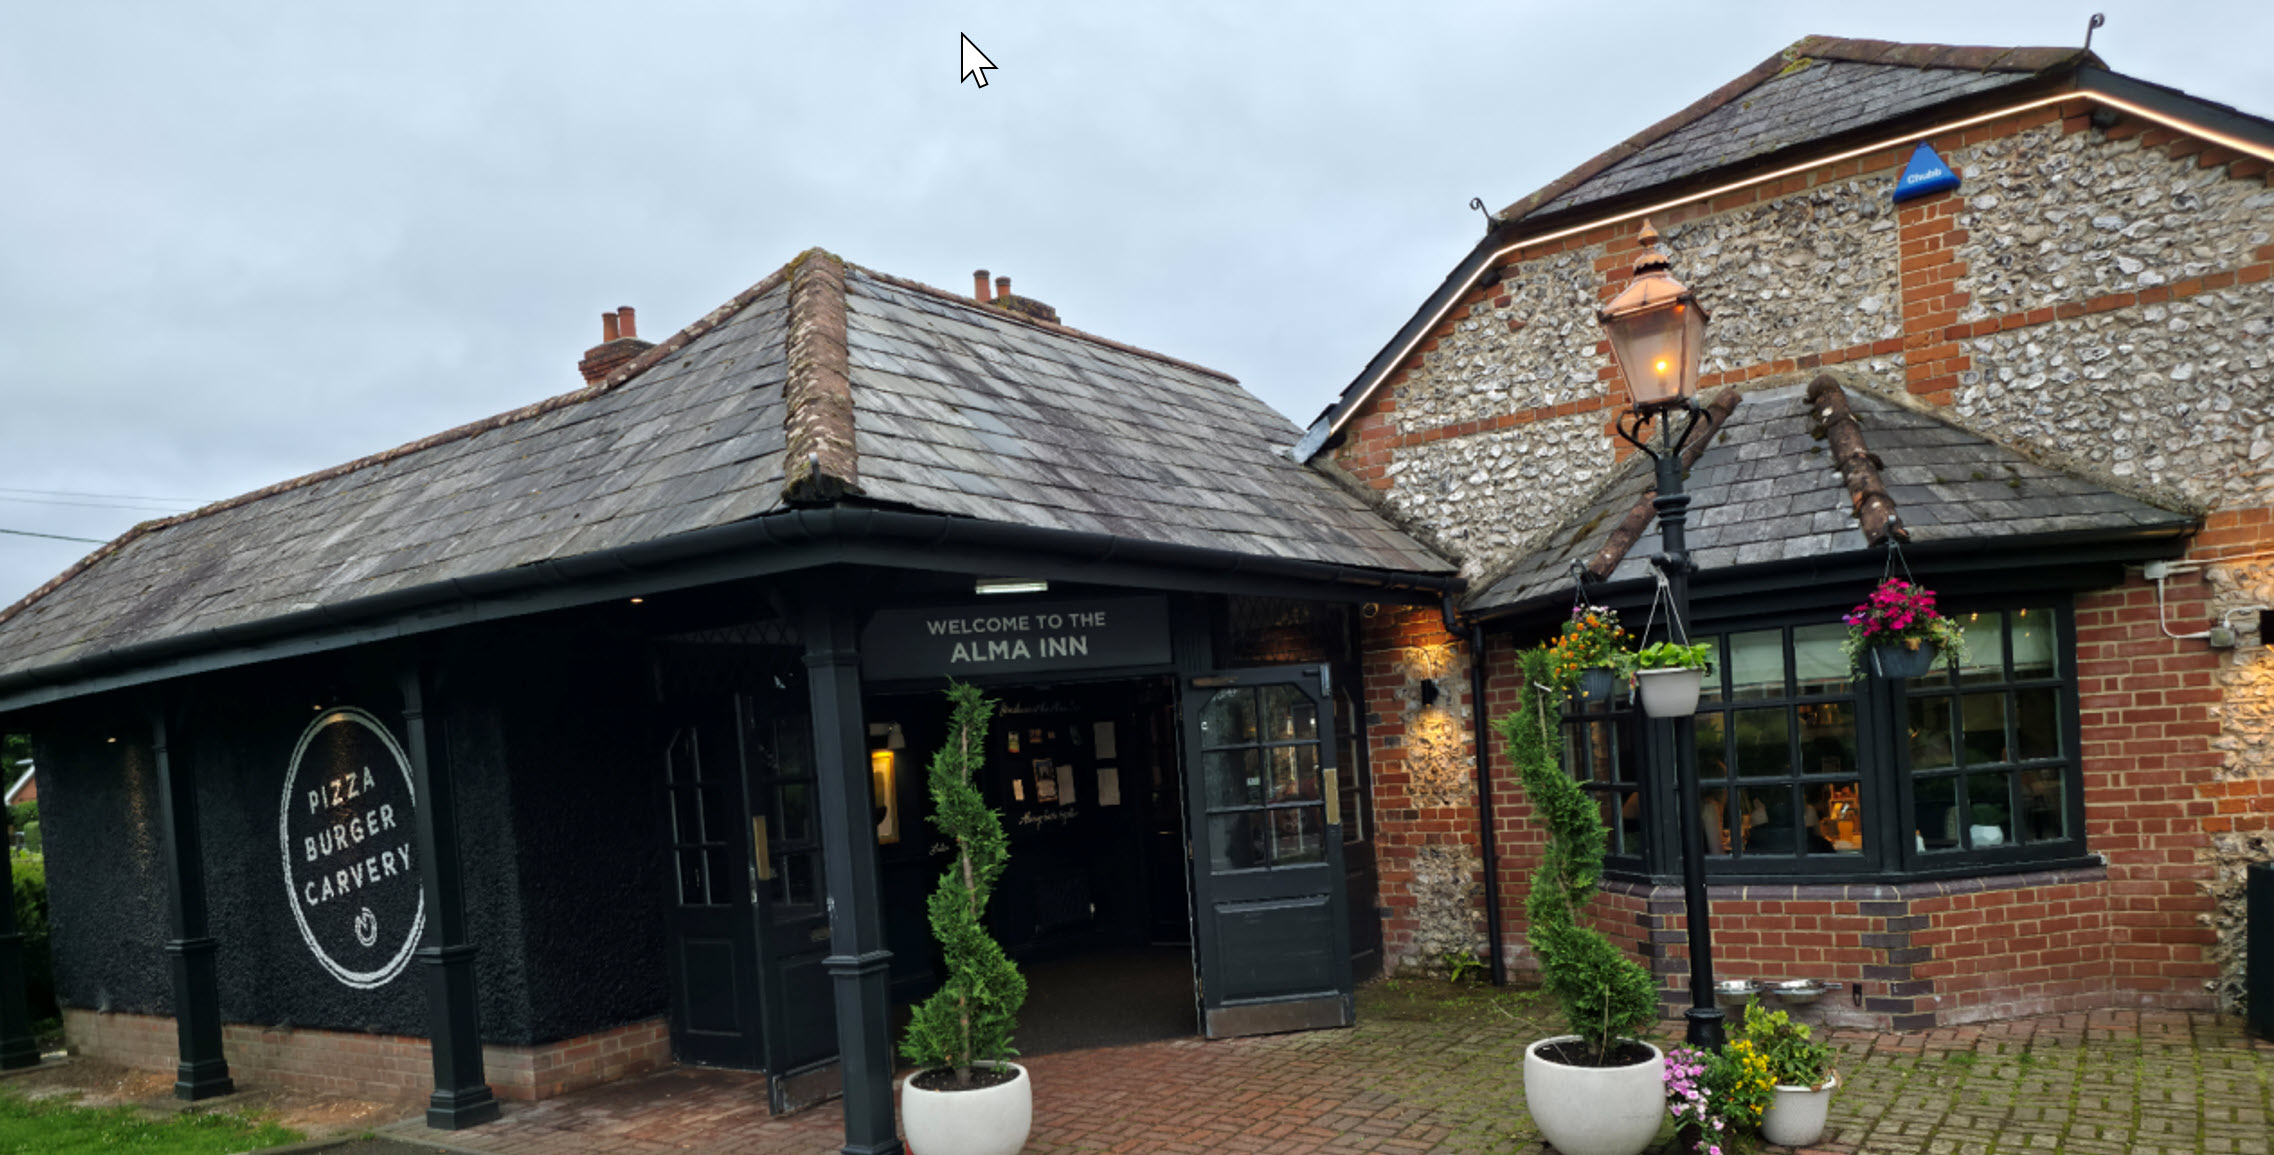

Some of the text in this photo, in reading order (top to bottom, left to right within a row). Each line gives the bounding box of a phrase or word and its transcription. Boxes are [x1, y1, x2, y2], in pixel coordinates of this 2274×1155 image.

[1907, 168, 1942, 184] Chubb
[926, 612, 1106, 635] WELCOME TO THE
[950, 635, 1088, 663] ALMA INN
[308, 766, 376, 815] PIZZA
[305, 804, 397, 862] BURGER
[305, 843, 411, 906] CARVERY
